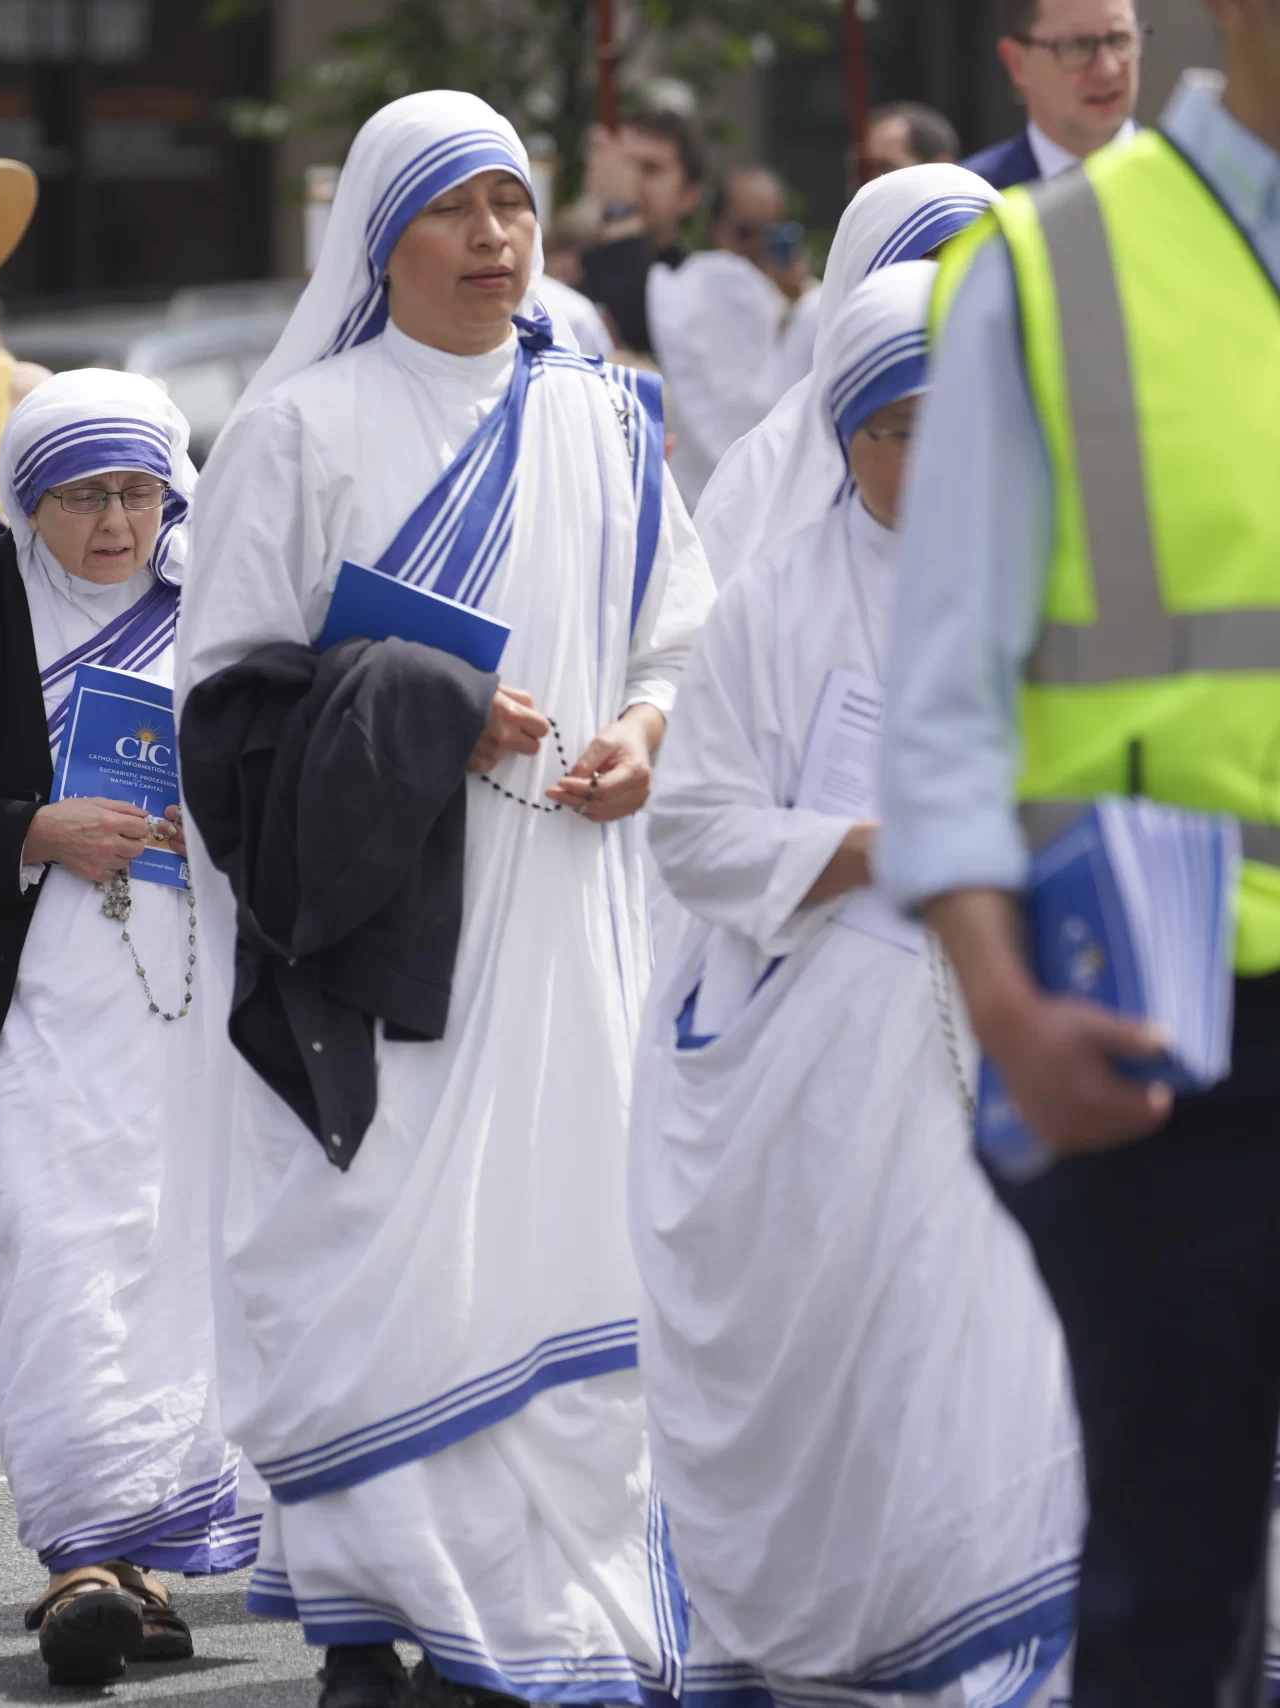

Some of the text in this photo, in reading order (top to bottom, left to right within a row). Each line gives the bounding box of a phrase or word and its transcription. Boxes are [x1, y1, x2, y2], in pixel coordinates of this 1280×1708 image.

[116, 737, 171, 766] CIC
[88, 753, 120, 765] CATHOLIC
[122, 760, 166, 774] INFORMATION
[99, 766, 177, 788] EUCHARISTIC PROCESSION
[110, 777, 138, 787] NATION'S
[139, 783, 163, 792] CAPITAL
